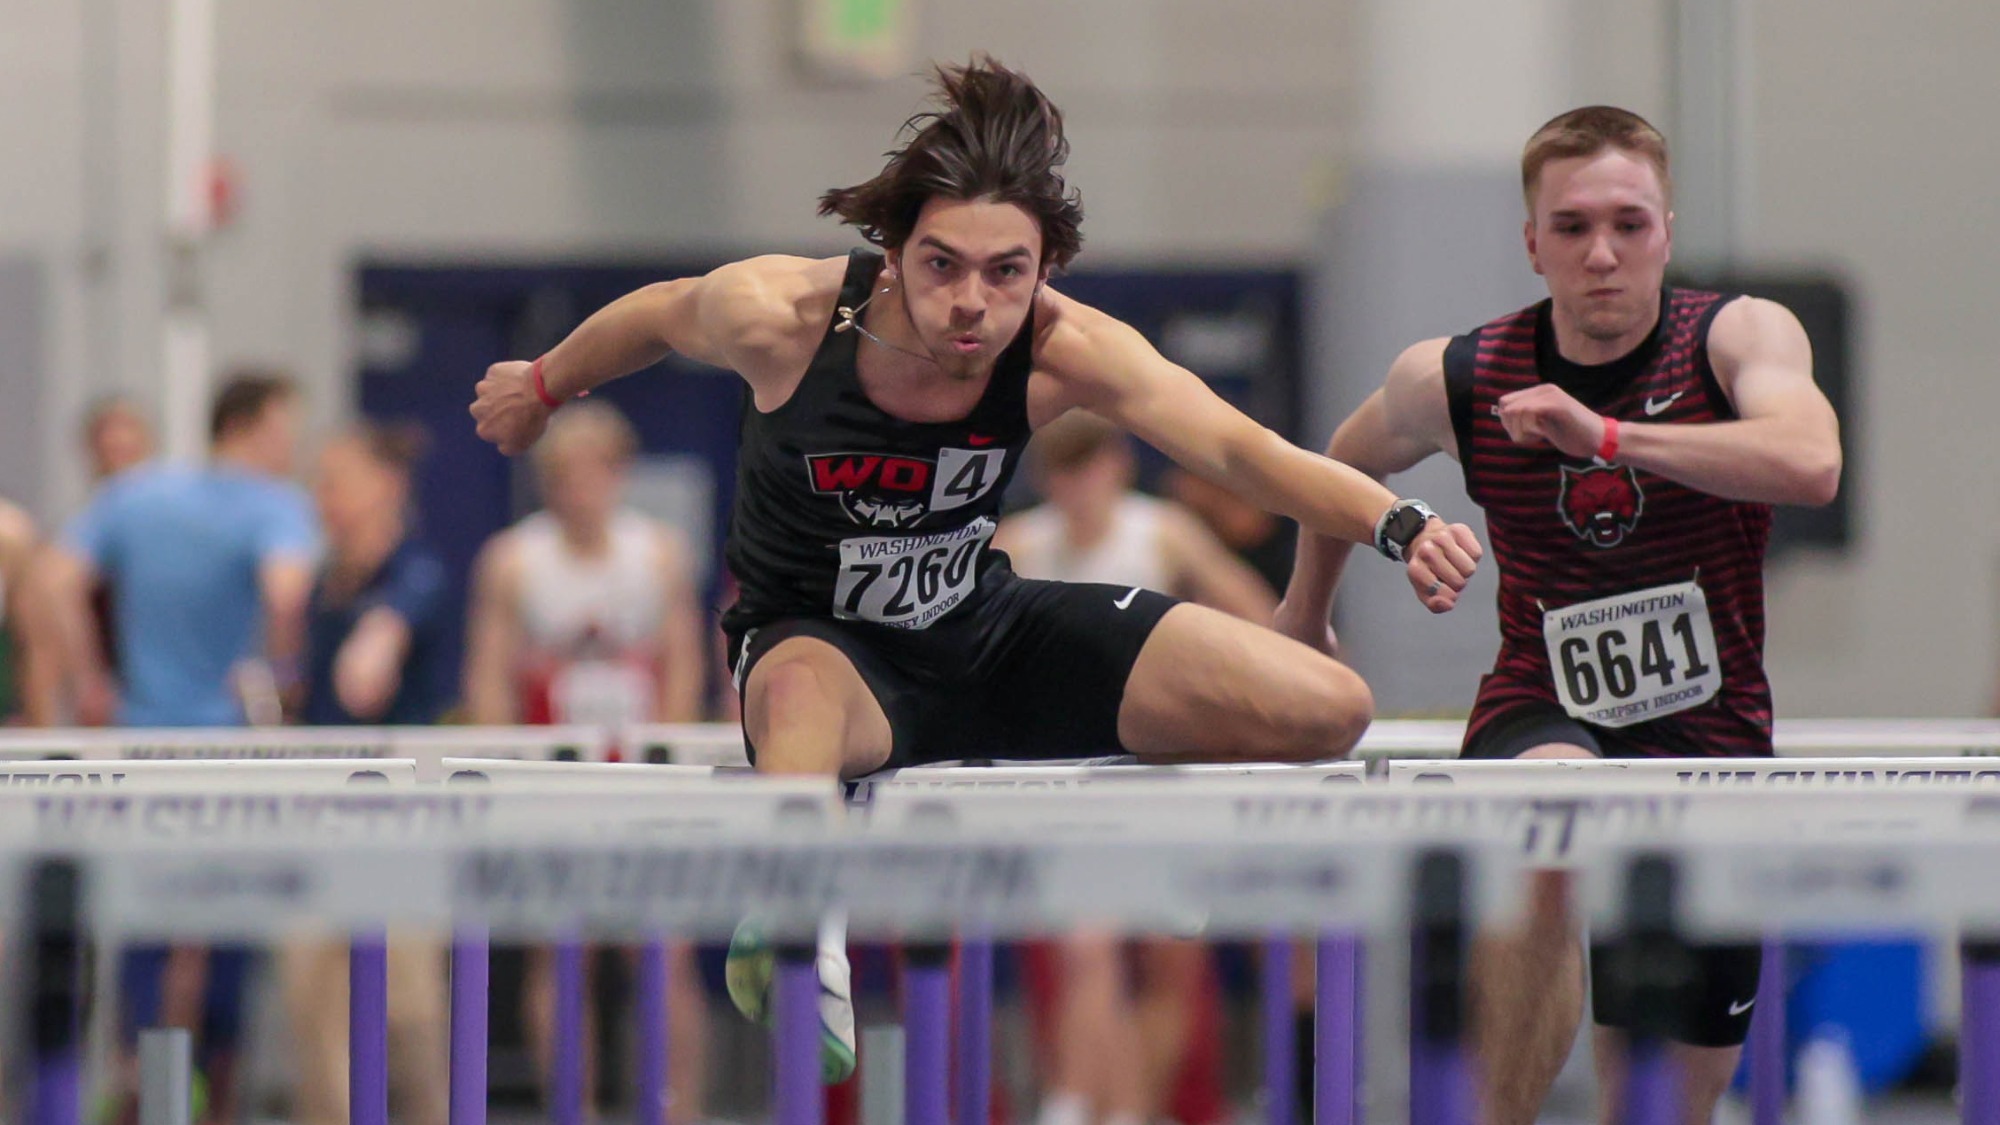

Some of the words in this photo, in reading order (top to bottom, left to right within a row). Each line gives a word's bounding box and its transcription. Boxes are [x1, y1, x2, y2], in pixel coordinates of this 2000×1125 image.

[943, 454, 988, 501] 4
[860, 523, 982, 559] WASHINGTON
[844, 539, 981, 617] 7260
[922, 592, 960, 623] INDOOR
[1560, 593, 1685, 631] WASHINGTON
[1560, 612, 1709, 706] 6641
[1586, 699, 1649, 720] DEMPSEY
[1654, 685, 1704, 709] INDOOR
